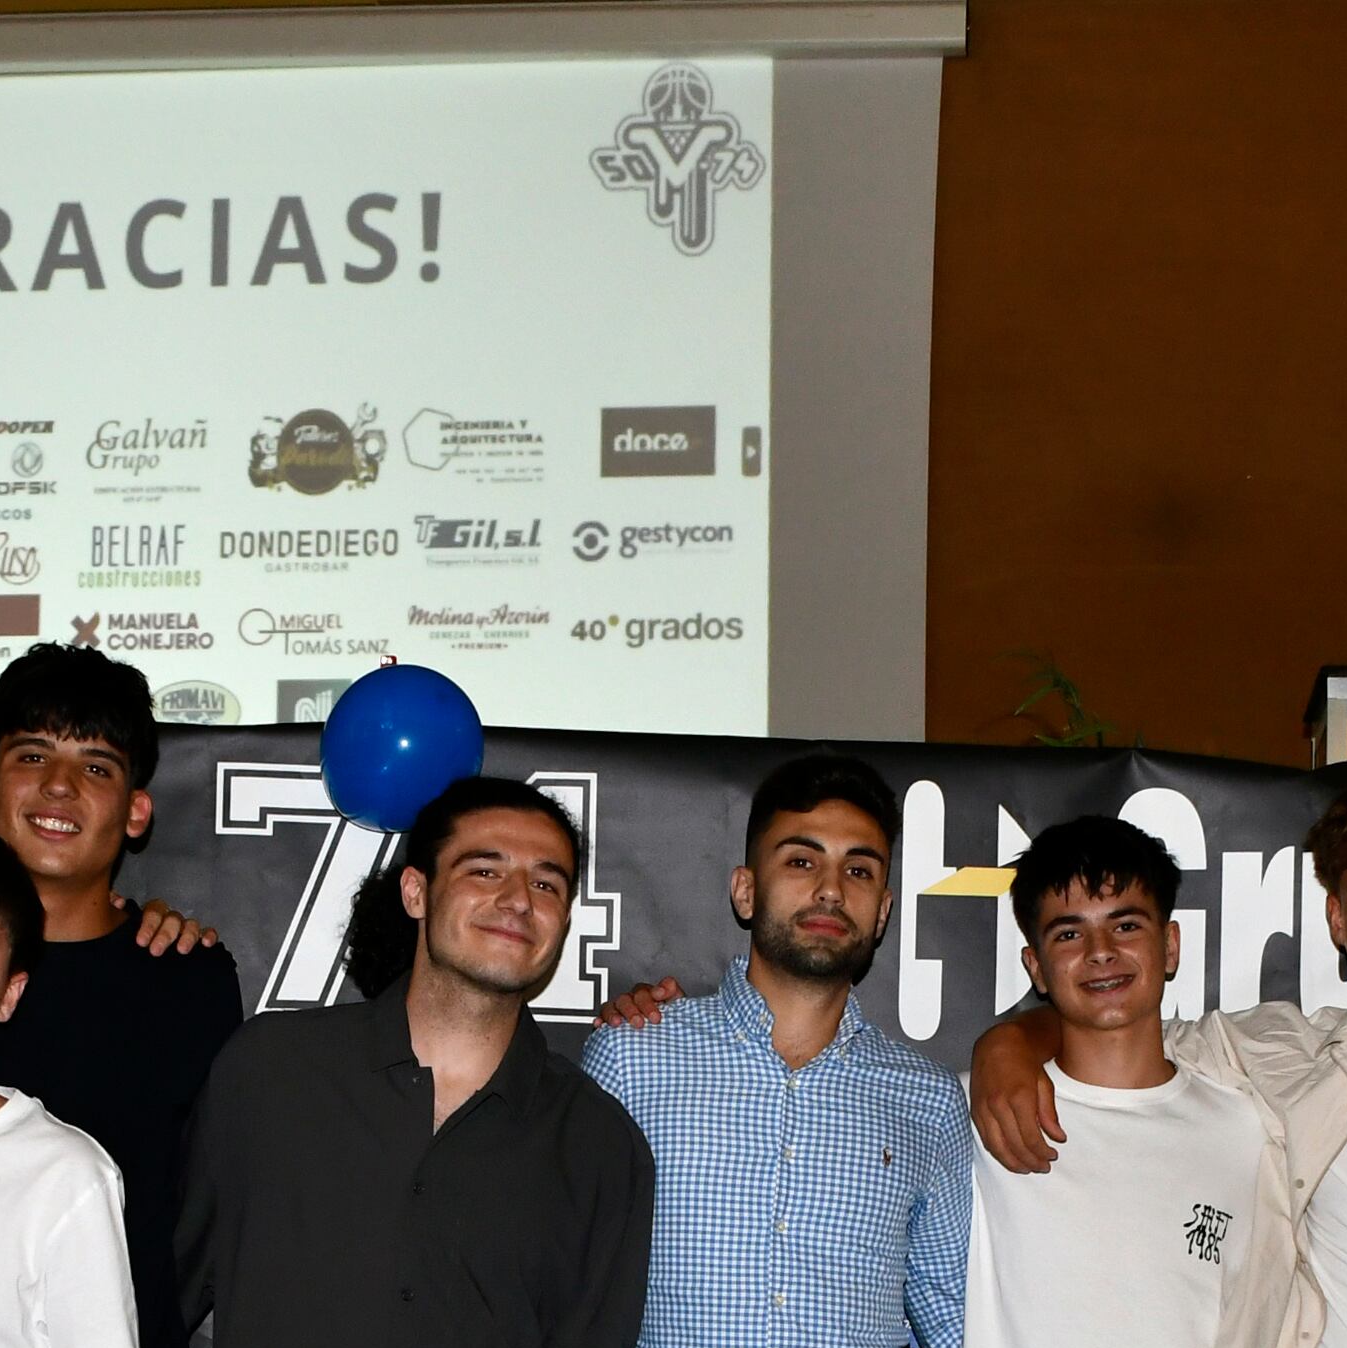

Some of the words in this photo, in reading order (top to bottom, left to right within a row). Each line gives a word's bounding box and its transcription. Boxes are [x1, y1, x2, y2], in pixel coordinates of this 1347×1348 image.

[96, 418, 208, 451] Galvañ
[86, 440, 161, 477] Grupo
[91, 525, 187, 567] BELRAF
[219, 529, 399, 558] DONDEDIEGO
[619, 523, 734, 559] gestycon
[264, 562, 349, 573] GASTROBAR
[77, 570, 201, 589] construcciones
[107, 613, 200, 631] MANUELA
[279, 614, 344, 631] MIGUEL
[408, 604, 474, 625] Molina
[107, 632, 214, 651] CONEJERO
[625, 612, 744, 648] grados
[284, 632, 342, 655] TOMÁS
[347, 638, 390, 655] SANZ
